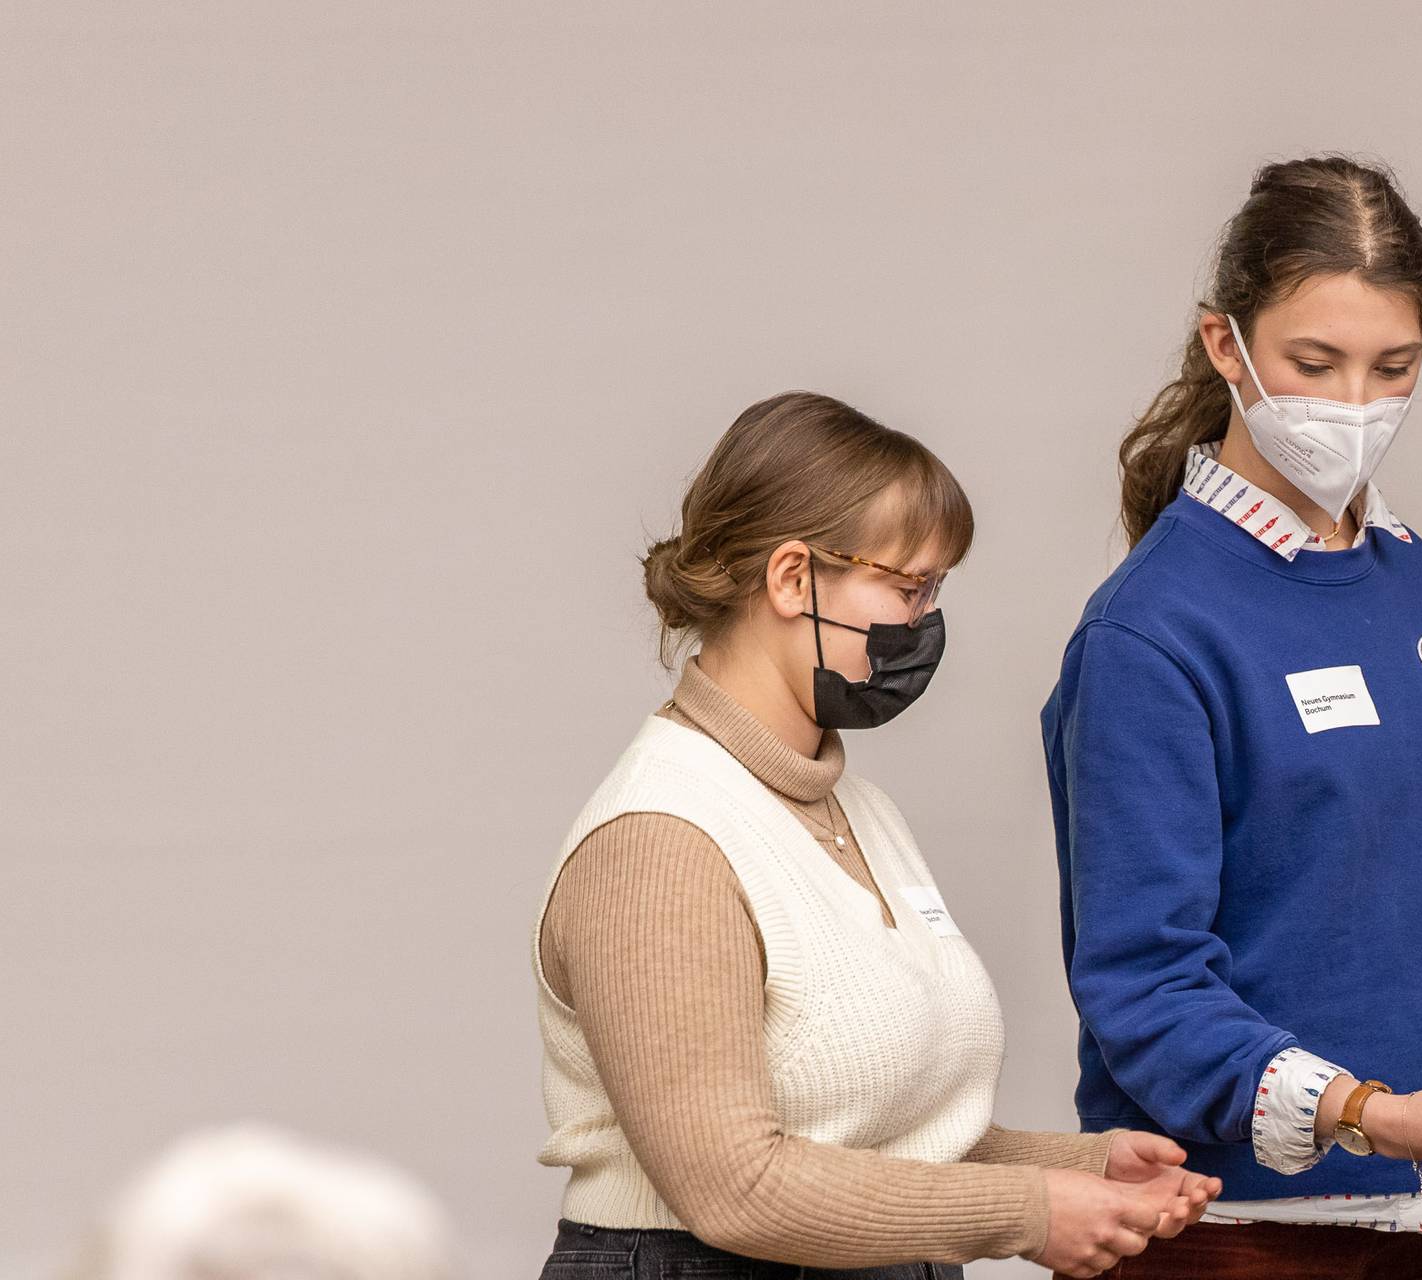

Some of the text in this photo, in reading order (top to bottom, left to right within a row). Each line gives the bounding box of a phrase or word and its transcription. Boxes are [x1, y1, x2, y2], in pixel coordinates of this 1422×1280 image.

[1301, 692, 1356, 706] Neues Gymnasium
[1304, 704, 1333, 716] Bochum
